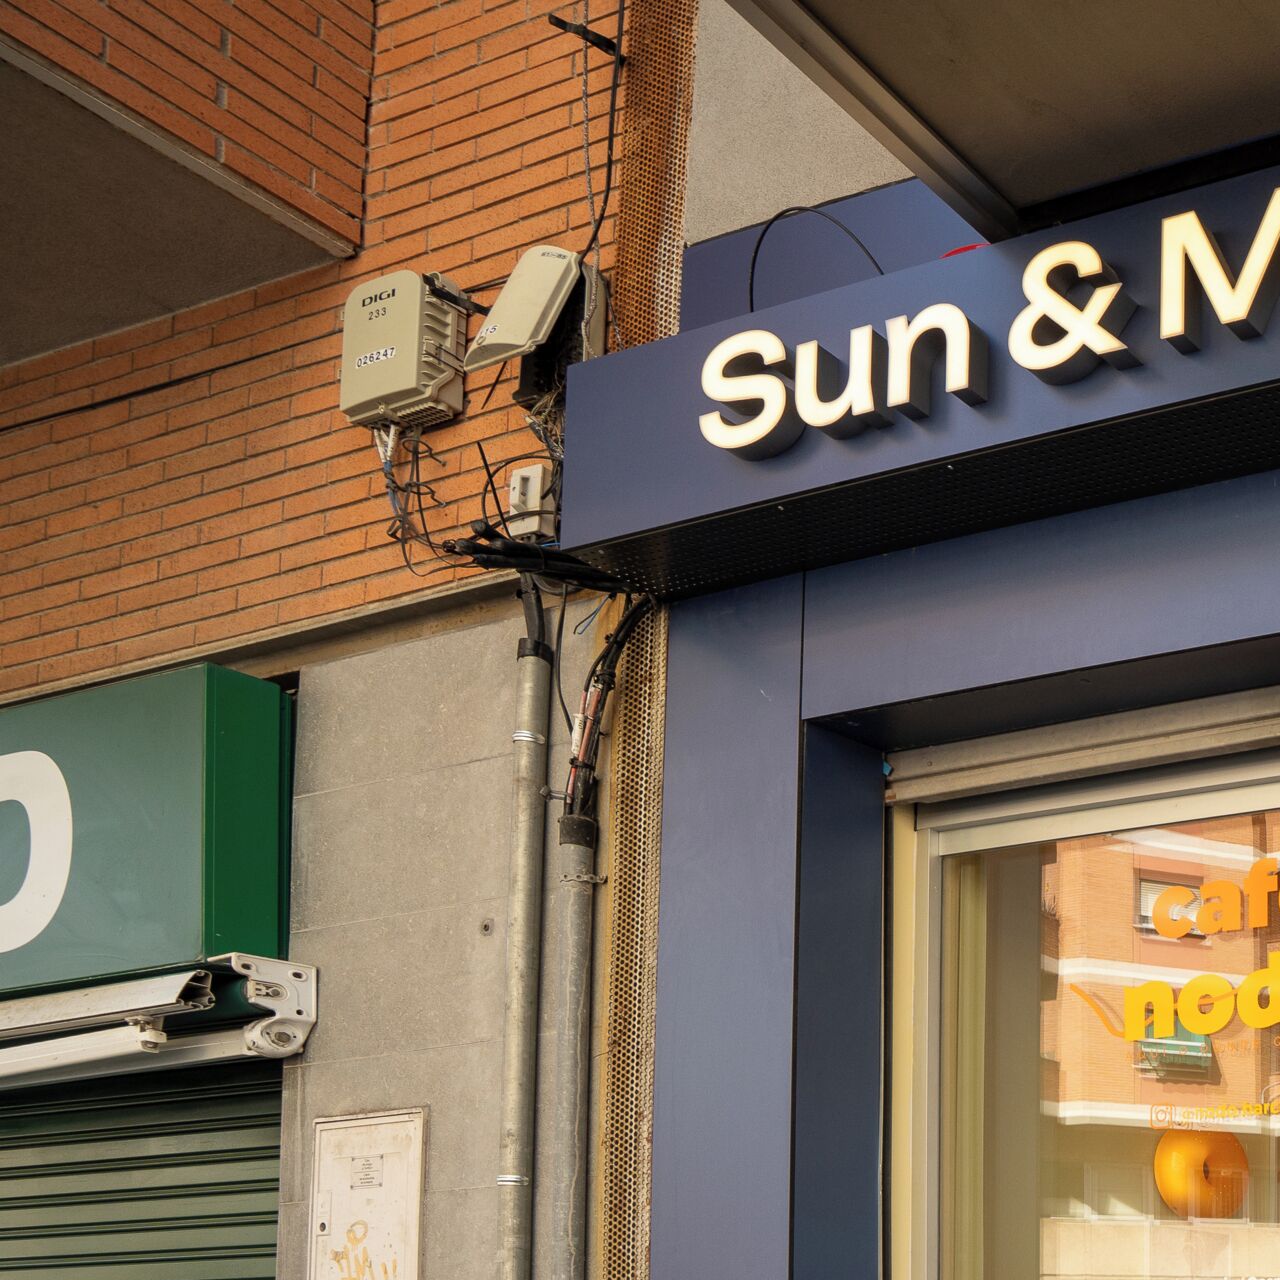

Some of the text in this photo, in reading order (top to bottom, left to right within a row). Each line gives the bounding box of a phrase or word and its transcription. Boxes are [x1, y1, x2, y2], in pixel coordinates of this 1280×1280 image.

[361, 288, 396, 307] DIGI
[368, 307, 387, 321] 233
[697, 302, 978, 453] Sun
[1007, 239, 1129, 373] &
[356, 347, 396, 368] 026247
